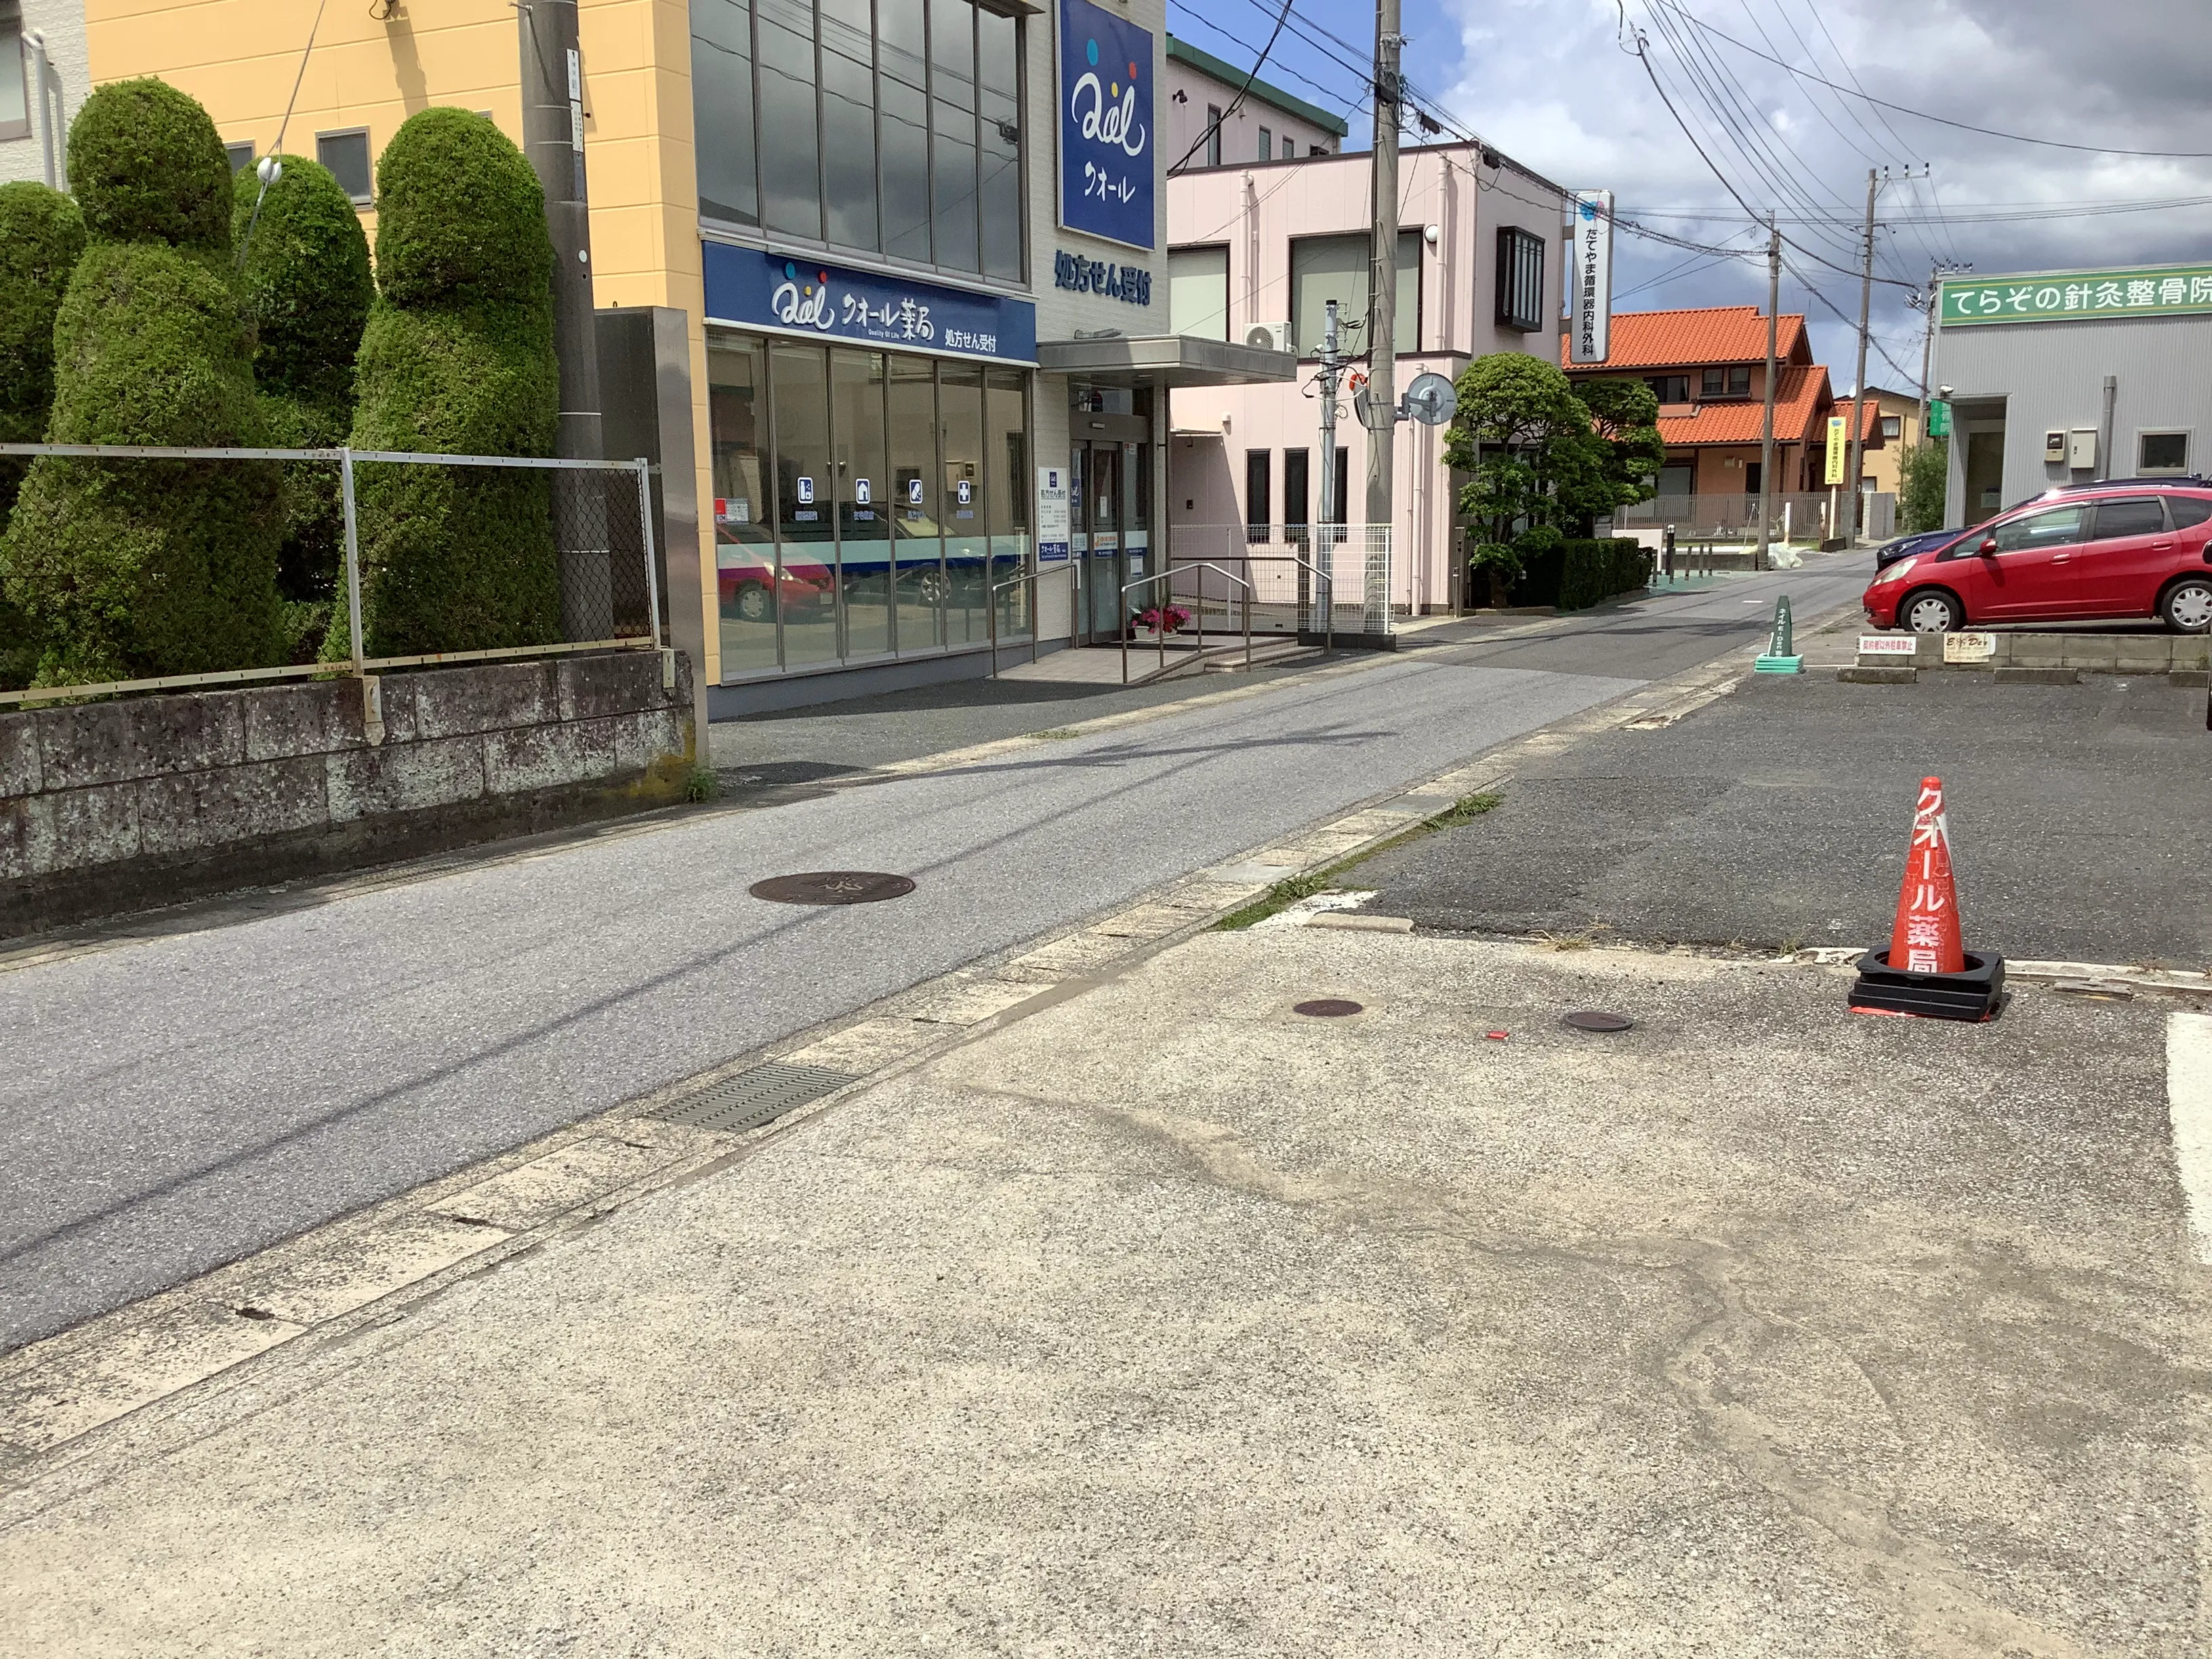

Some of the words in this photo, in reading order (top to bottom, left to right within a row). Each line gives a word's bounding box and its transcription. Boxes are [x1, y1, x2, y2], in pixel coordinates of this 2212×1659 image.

[1084, 161, 1136, 204] クオール
[1054, 249, 1152, 306] 処方せん受付
[1582, 228, 1597, 356] たてやま循環器内科外科
[842, 293, 935, 342] クオール薬局
[945, 328, 996, 353] 処方せん受付
[1907, 787, 1946, 973] クオール薬局
